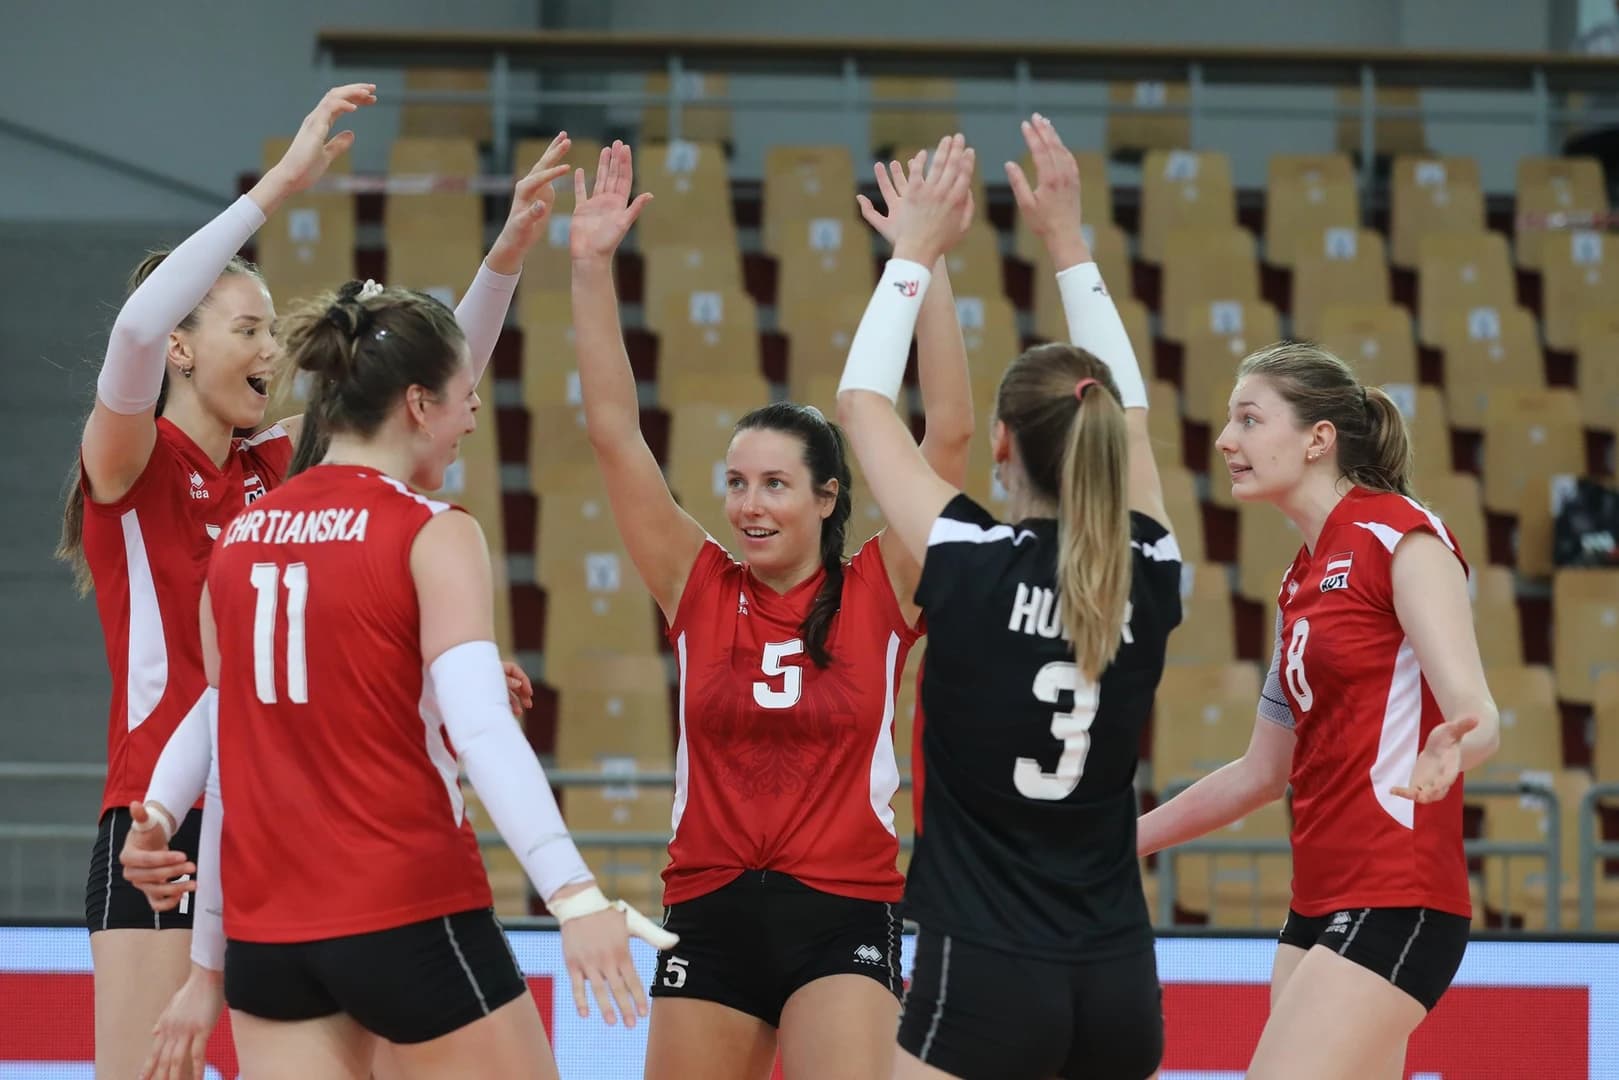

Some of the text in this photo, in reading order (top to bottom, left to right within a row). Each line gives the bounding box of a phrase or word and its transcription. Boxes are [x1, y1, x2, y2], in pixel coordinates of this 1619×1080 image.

[249, 562, 309, 704] 11
[1008, 582, 1135, 645] HUR
[753, 639, 804, 709] 5
[1286, 617, 1314, 713] 8
[1013, 661, 1101, 801] 3
[663, 955, 689, 988] 5
